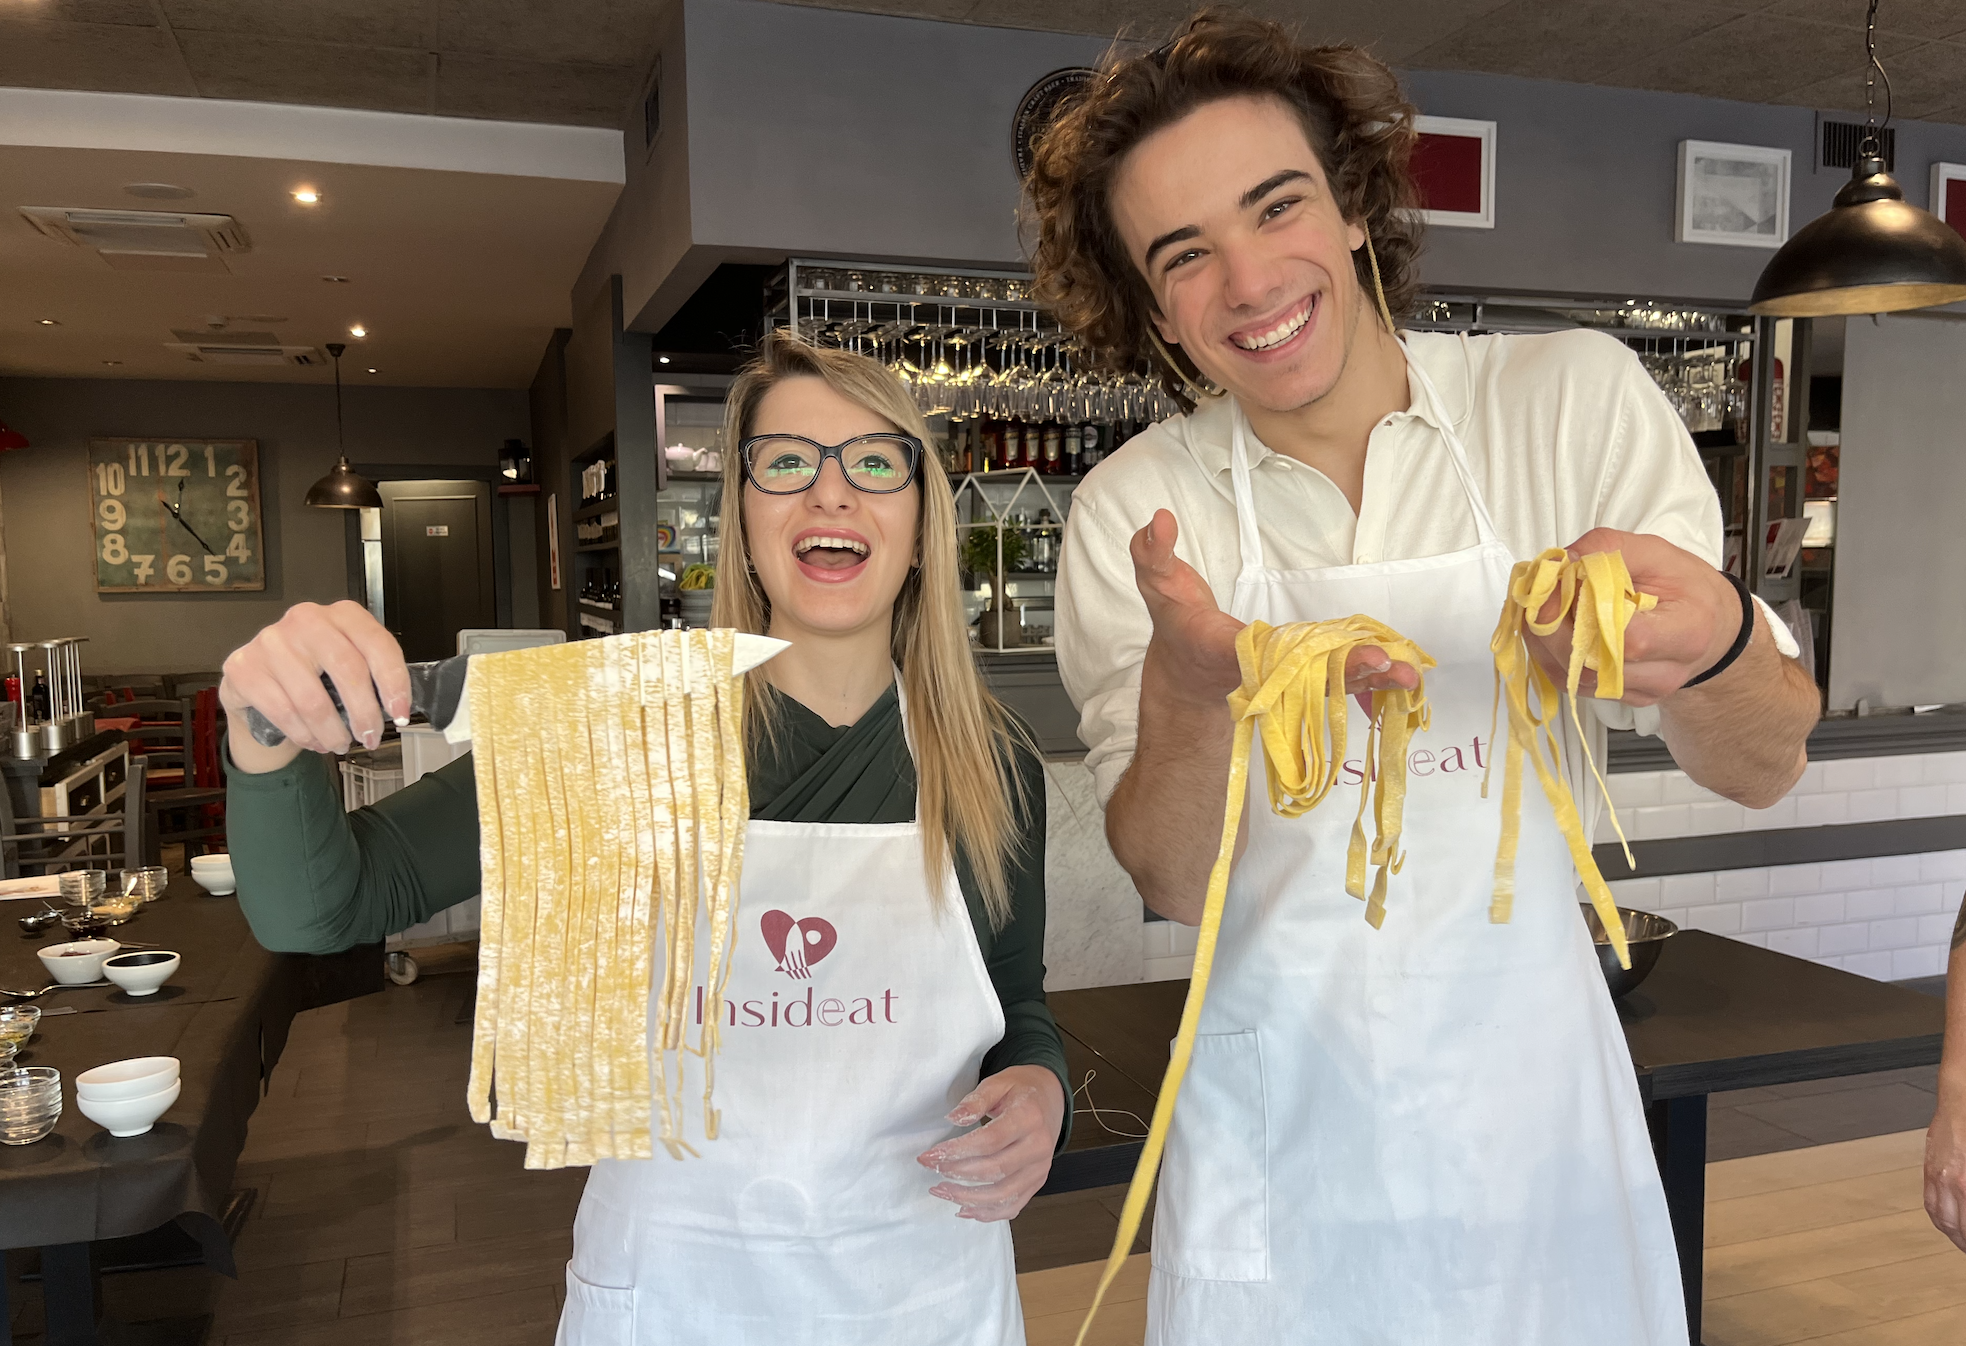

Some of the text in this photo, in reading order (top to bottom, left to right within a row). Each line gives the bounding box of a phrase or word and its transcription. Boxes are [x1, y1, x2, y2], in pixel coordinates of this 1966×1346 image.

[128, 443, 150, 477] 11
[155, 443, 191, 477] 12
[204, 444, 216, 477] 1
[96, 462, 126, 496] 10
[225, 464, 248, 497] 2
[99, 498, 127, 531] 9
[226, 499, 250, 532] 3
[102, 533, 129, 565] 8
[225, 533, 252, 564] 4
[130, 554, 156, 585] 7
[166, 554, 193, 585] 6
[203, 554, 228, 585] 5
